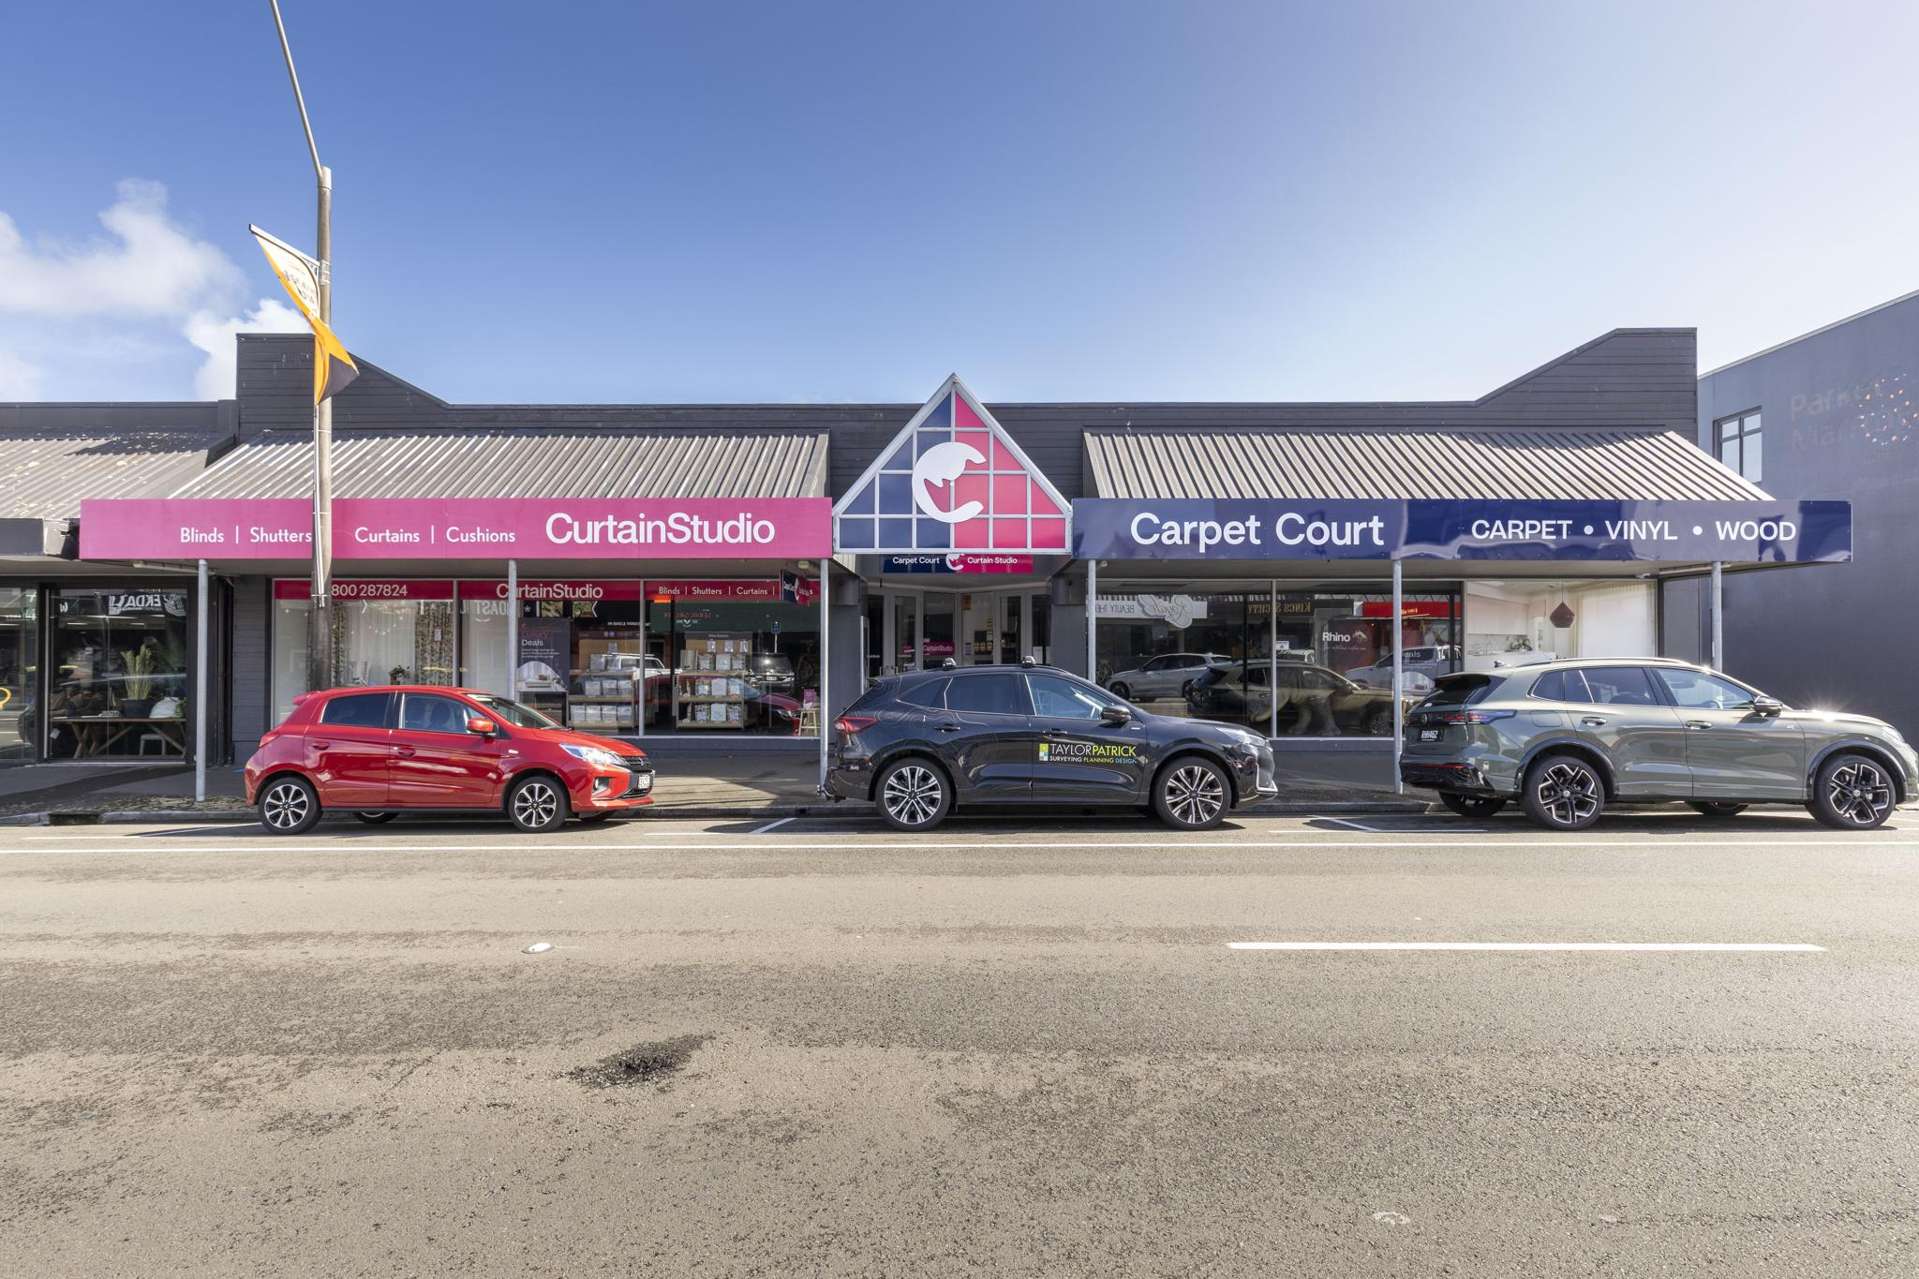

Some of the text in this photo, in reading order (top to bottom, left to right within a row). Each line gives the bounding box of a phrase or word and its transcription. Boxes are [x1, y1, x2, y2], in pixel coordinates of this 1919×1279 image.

[545, 512, 776, 544] CurtainStudio
[1130, 512, 1385, 554] Carpet Court
[1471, 518, 1797, 541] CARPET VINYL WOOD
[180, 526, 312, 544] Blinds Shutters
[354, 526, 516, 544] Curtains Cushions
[892, 556, 940, 567] Carpet Court
[967, 556, 1018, 565] Curtain Studio
[331, 584, 408, 597] 800 287824
[495, 583, 604, 599] CrtainStudio
[658, 585, 768, 596] Blinds Shutters Curtains
[521, 639, 545, 648] Deals
[1322, 631, 1351, 643] Rhino
[1050, 743, 1136, 756] TAYLORPATRICK
